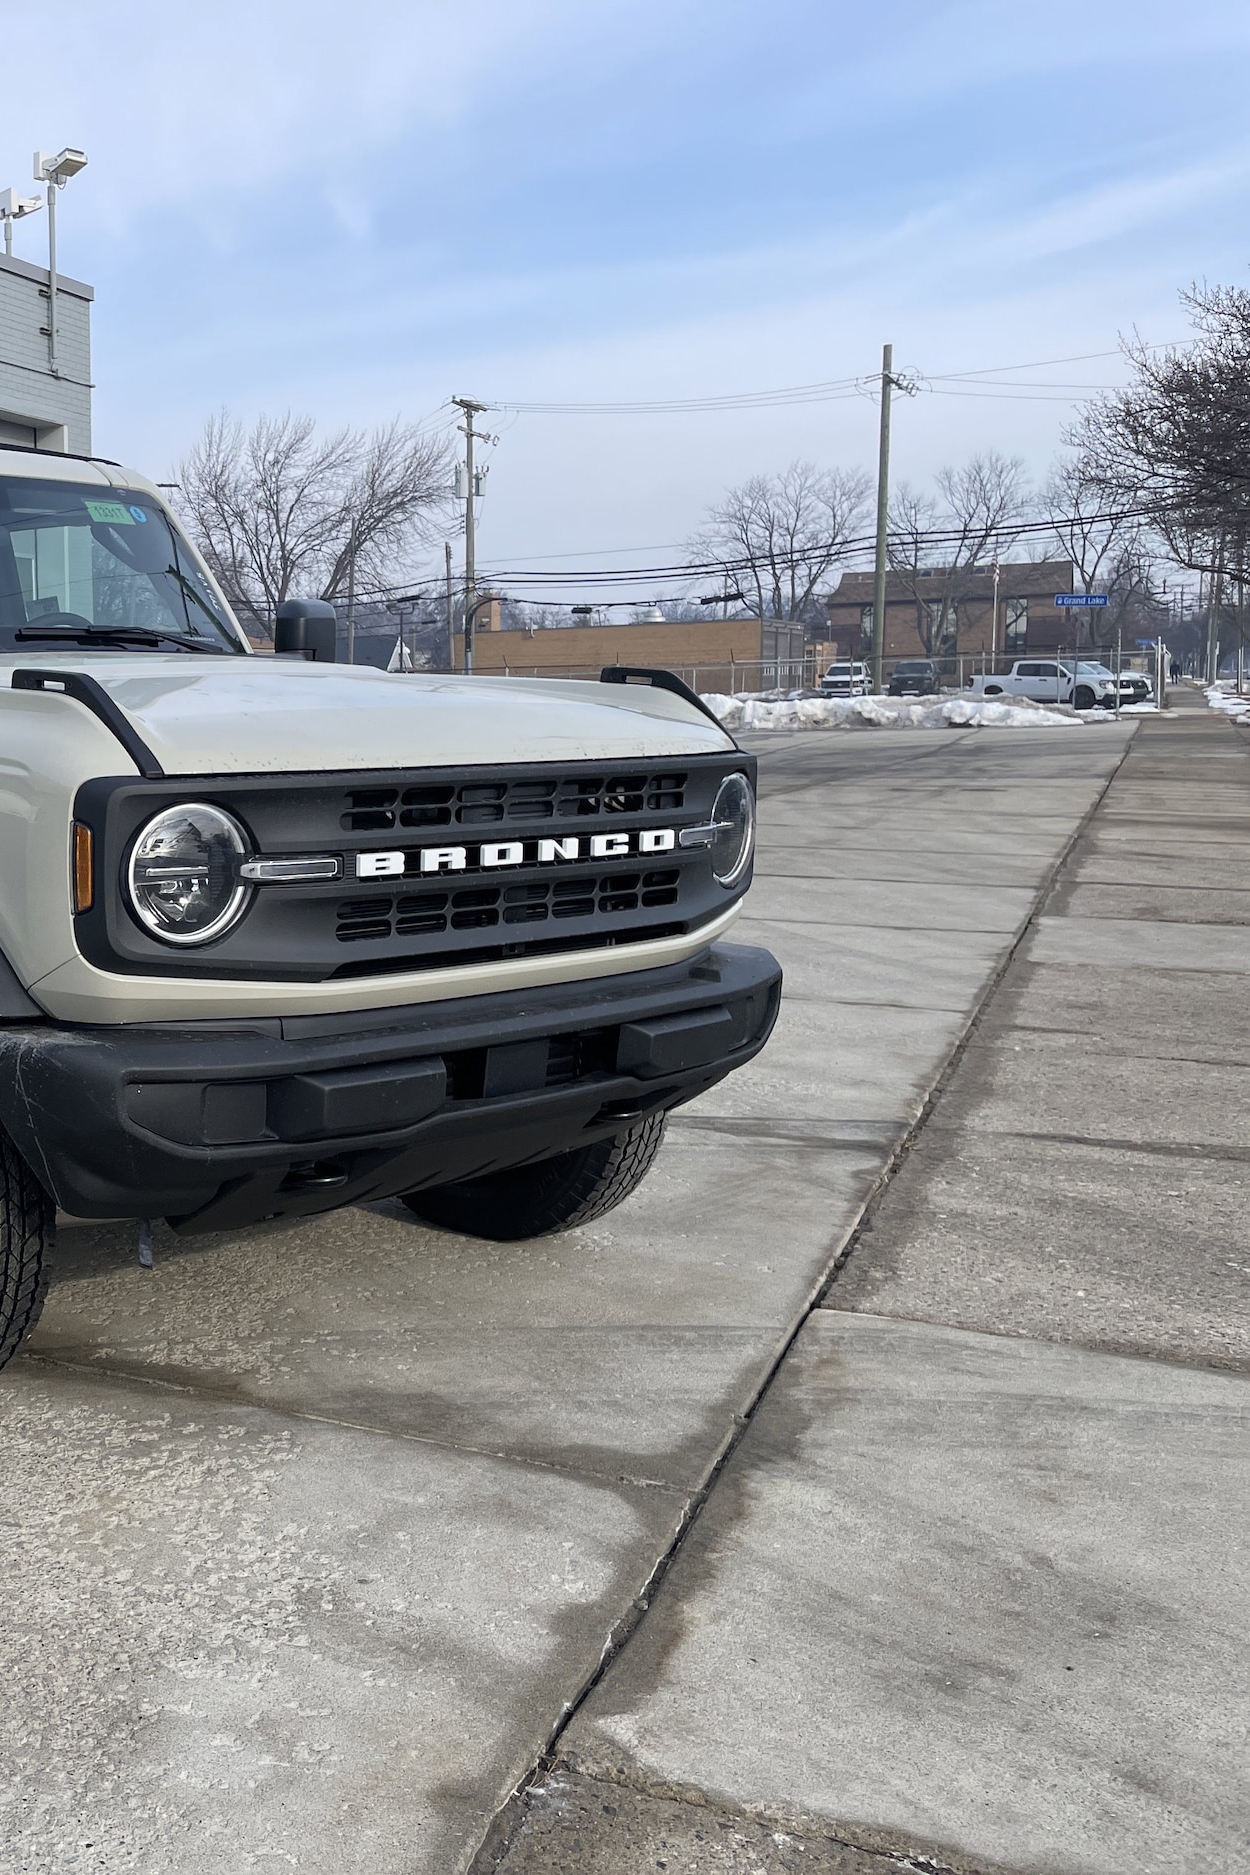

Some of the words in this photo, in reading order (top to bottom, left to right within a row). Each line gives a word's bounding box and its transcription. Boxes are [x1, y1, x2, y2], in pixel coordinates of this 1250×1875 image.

[1063, 597, 1086, 605] Grand
[1088, 597, 1105, 605] Lake
[356, 828, 676, 878] BRONCO
